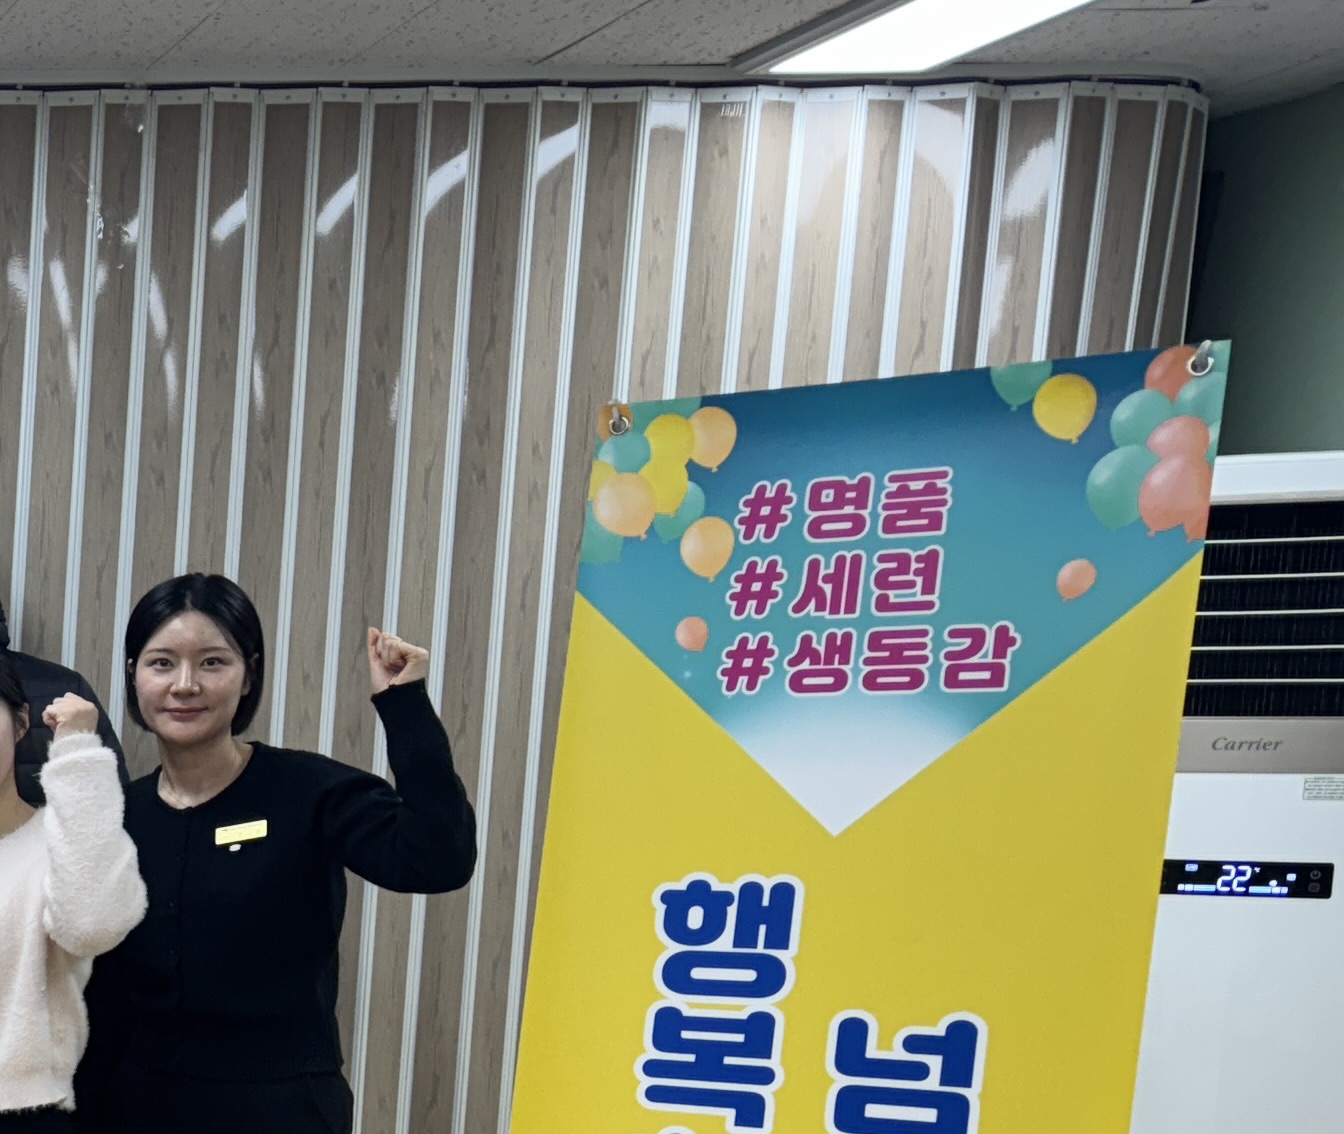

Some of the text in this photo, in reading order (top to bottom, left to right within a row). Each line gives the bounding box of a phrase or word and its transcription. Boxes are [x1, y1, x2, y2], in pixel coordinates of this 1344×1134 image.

[740, 471, 952, 540] #명품
[731, 549, 942, 616] #세련
[722, 624, 1018, 694] #생동감
[1211, 737, 1284, 752] Carrier
[1216, 864, 1253, 892] 22
